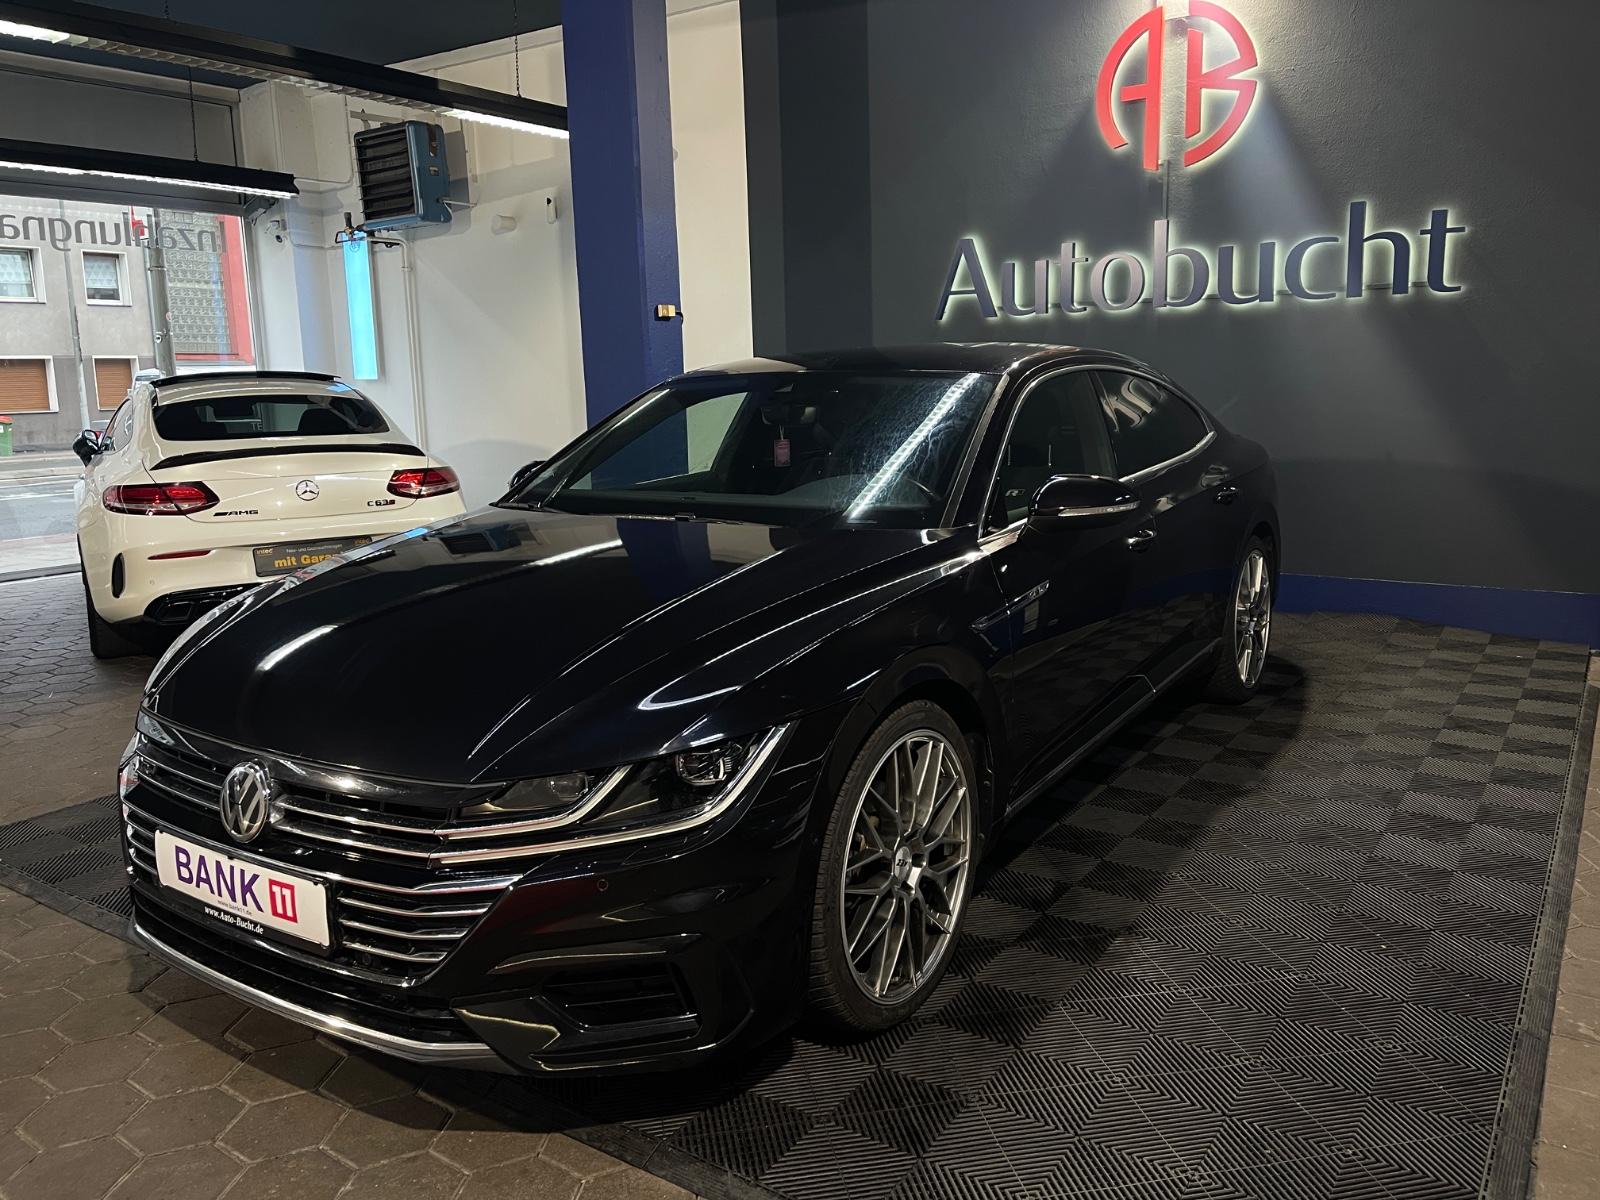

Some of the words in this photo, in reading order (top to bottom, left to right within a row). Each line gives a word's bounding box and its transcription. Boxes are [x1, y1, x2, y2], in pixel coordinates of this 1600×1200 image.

[935, 200, 1466, 321] Autobucht
[274, 555, 297, 568] mit
[301, 553, 338, 565] Gara
[174, 845, 265, 913] BANK
[204, 906, 264, 934] www.Auto-Bucht.de
